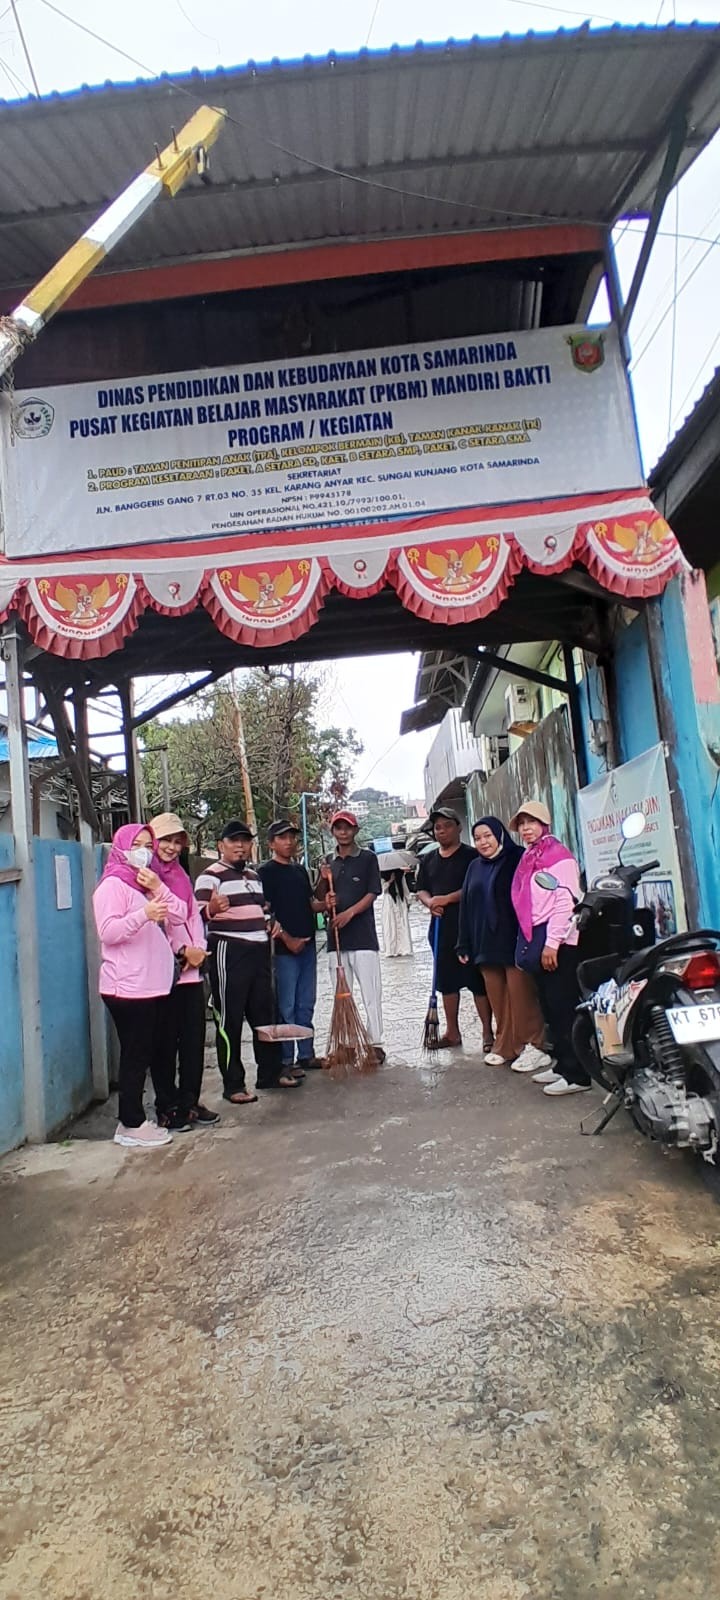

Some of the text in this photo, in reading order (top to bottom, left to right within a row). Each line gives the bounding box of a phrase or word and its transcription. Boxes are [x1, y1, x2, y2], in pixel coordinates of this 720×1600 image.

[98, 341, 518, 408] DINAS PENDIDIKAN DAN KEBUDAYAAN KOTA SAMARINDA
[70, 415, 118, 438] PUSAT
[121, 407, 194, 433] KEGIATAN
[197, 399, 261, 424] BELAJAR
[264, 386, 366, 416] MASYARAKAT
[370, 380, 428, 403] (PKBM)
[431, 371, 500, 396] MANDIRI
[503, 365, 552, 388] BAKTI
[228, 411, 393, 448] PROGRAM / KEGIATAN
[88, 469, 97, 480] 1.
[98, 467, 127, 479] PAUD
[133, 461, 169, 474] TAMAN
[171, 456, 220, 470] PENITIPAN
[222, 453, 251, 465] ANAK
[281, 442, 337, 458] KELOMPOK
[338, 437, 382, 450] BERMAIN
[408, 429, 445, 442] TAMAN
[522, 417, 541, 431] (TK)
[88, 482, 98, 492] 2.
[100, 476, 150, 491] PROGRAM
[152, 469, 214, 486] KESETARAAN
[255, 464, 264, 473] A
[265, 460, 301, 473] SETARA
[349, 453, 357, 462] B
[359, 447, 396, 461] SETARA
[458, 439, 467, 449] C
[468, 435, 505, 448] SETARA
[506, 432, 531, 444] SMA
[287, 467, 341, 480] SEKRETARIAT
[96, 507, 112, 515] JLN.
[115, 498, 164, 512] BANGGERIS
[167, 496, 194, 505] GANG
[205, 491, 229, 502] RT.03
[251, 488, 262, 497] 35
[284, 481, 321, 493] KARANG
[324, 477, 354, 488] ANYAR
[377, 471, 412, 482] SUNGAI
[414, 466, 457, 477] KUNJANG
[460, 462, 484, 473] KOTA
[487, 457, 540, 470] SAMARINDA
[281, 495, 303, 504] NPSN
[246, 506, 300, 518] OPERASIONAL
[266, 515, 294, 524] BADAN
[295, 511, 325, 521] HUKUM
[432, 586, 487, 601] INDONESIA
[241, 608, 298, 623] INDONESIA
[57, 622, 113, 636] INDONESIA
[671, 1010, 690, 1025] KT
